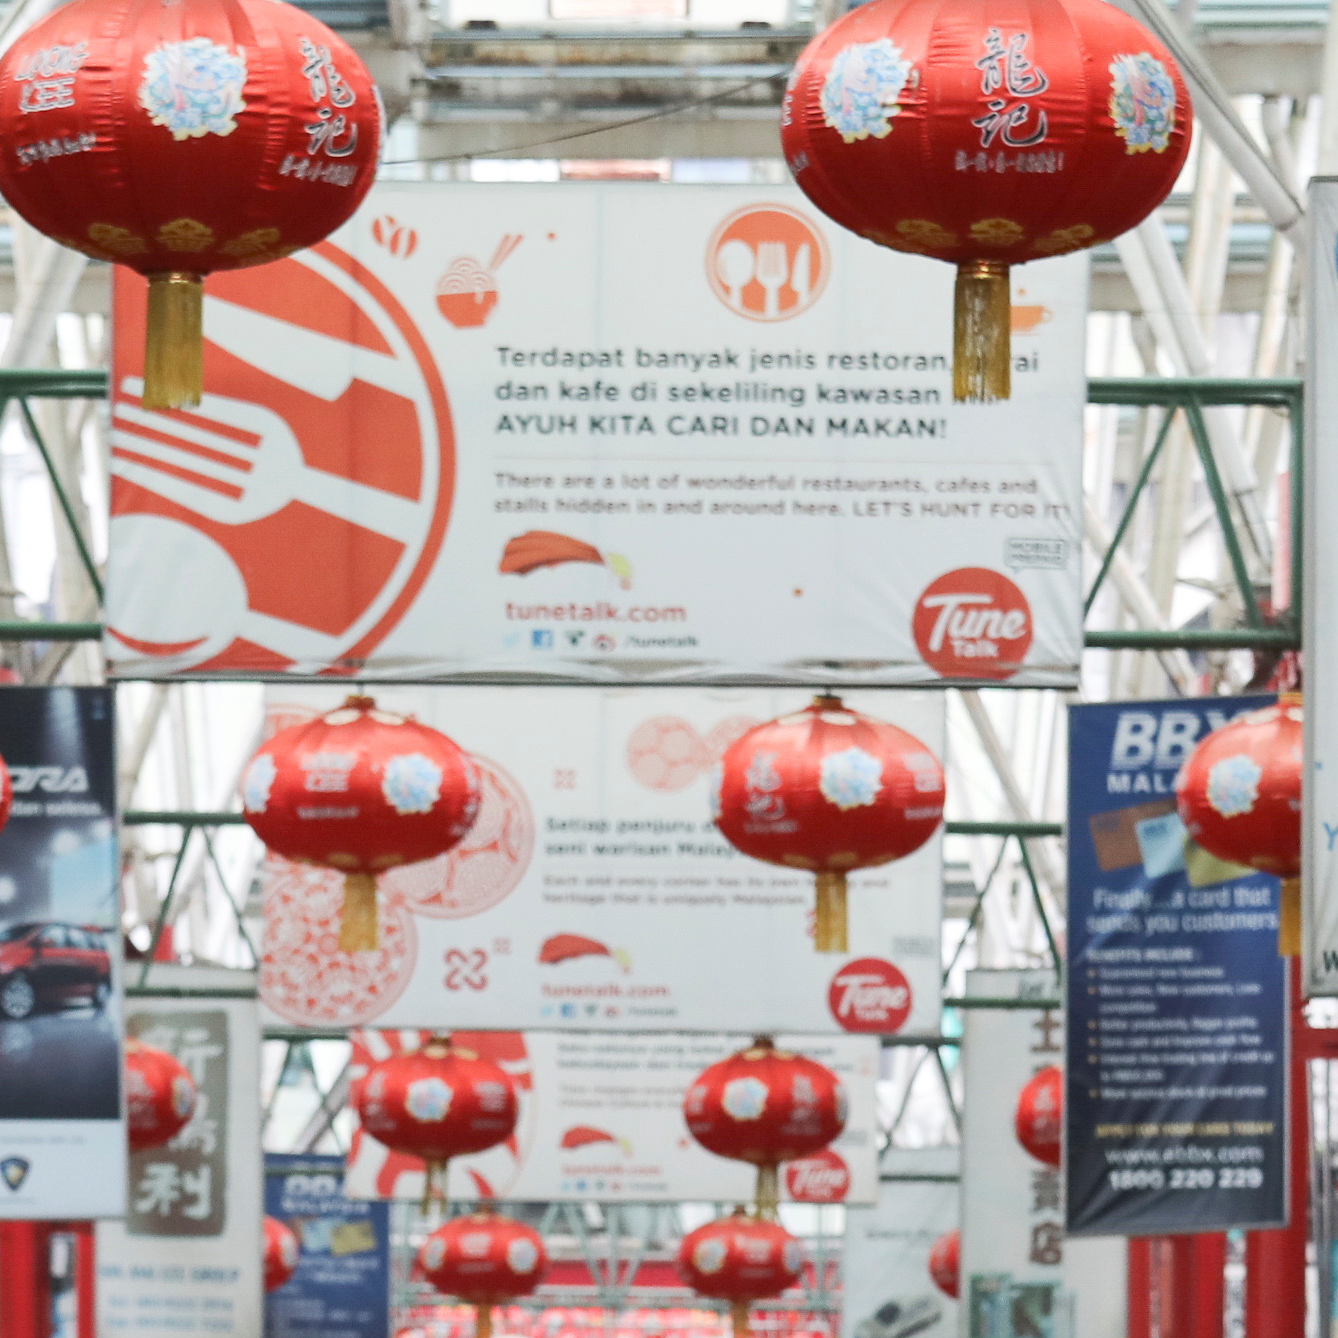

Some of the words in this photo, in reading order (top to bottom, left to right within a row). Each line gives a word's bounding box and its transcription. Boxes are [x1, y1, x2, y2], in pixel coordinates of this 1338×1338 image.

[971, 26, 1049, 148] 龍記
[496, 346, 624, 370] Terdapat
[636, 347, 740, 371] banyak
[749, 348, 816, 373] jenis
[495, 381, 548, 401] dan
[559, 381, 619, 401] kafe
[630, 381, 658, 401] di
[667, 382, 806, 406] sekeliling
[817, 384, 941, 405] kawasan
[495, 414, 577, 435] AYUH
[589, 415, 656, 436] KITA
[667, 415, 739, 436] CARI
[750, 416, 814, 437] DAN
[826, 417, 947, 438] MAKAN!
[494, 472, 554, 488] There
[563, 475, 596, 488] are
[603, 476, 613, 488] a
[620, 473, 650, 489] lot
[658, 473, 681, 489] of
[688, 474, 796, 490] wonderful
[802, 475, 928, 493] restaurants,
[935, 475, 991, 493] cafes
[998, 476, 1038, 493] and
[556, 499, 631, 514] hidden
[637, 499, 657, 514] in
[665, 499, 703, 514] and
[710, 500, 786, 515] around
[921, 502, 981, 518] HUNT
[990, 503, 1036, 519] FOR
[505, 602, 687, 622] tunetalk.com
[922, 592, 1028, 652] Tune
[951, 639, 1000, 658] Talk
[835, 973, 908, 1017] Tune
